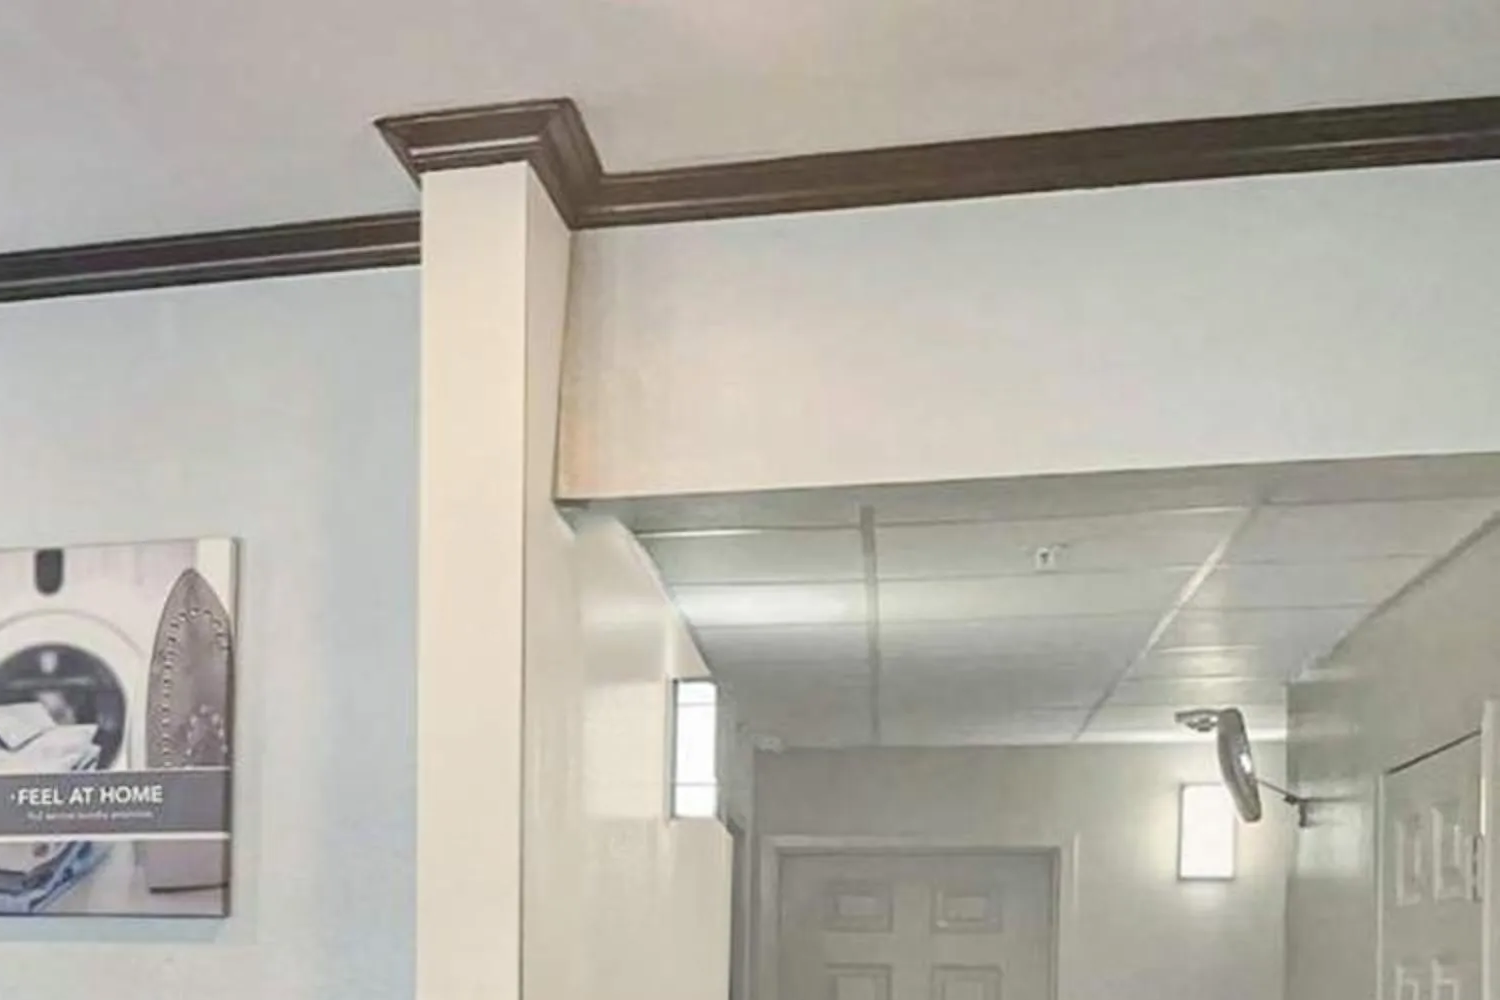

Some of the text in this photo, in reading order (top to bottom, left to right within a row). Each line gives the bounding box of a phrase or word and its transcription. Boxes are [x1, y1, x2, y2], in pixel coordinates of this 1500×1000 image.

[17, 785, 163, 805] FEEL AT HOME
